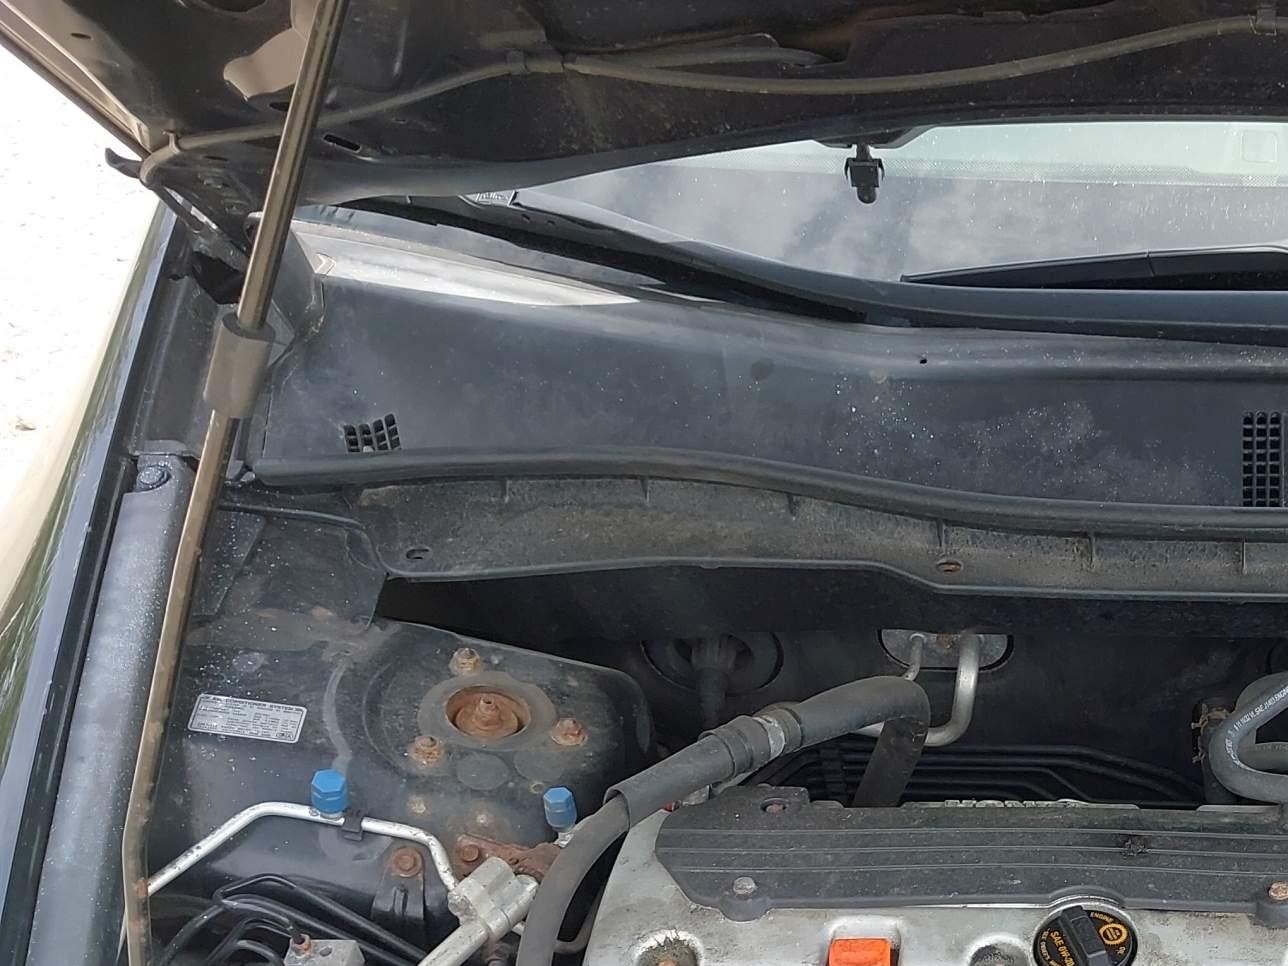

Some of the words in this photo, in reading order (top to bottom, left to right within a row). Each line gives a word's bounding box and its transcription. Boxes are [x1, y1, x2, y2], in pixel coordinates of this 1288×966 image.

[1090, 912, 1114, 922] ENGINE
[1050, 931, 1064, 947] SAE
[1058, 945, 1076, 966] 0W-20
